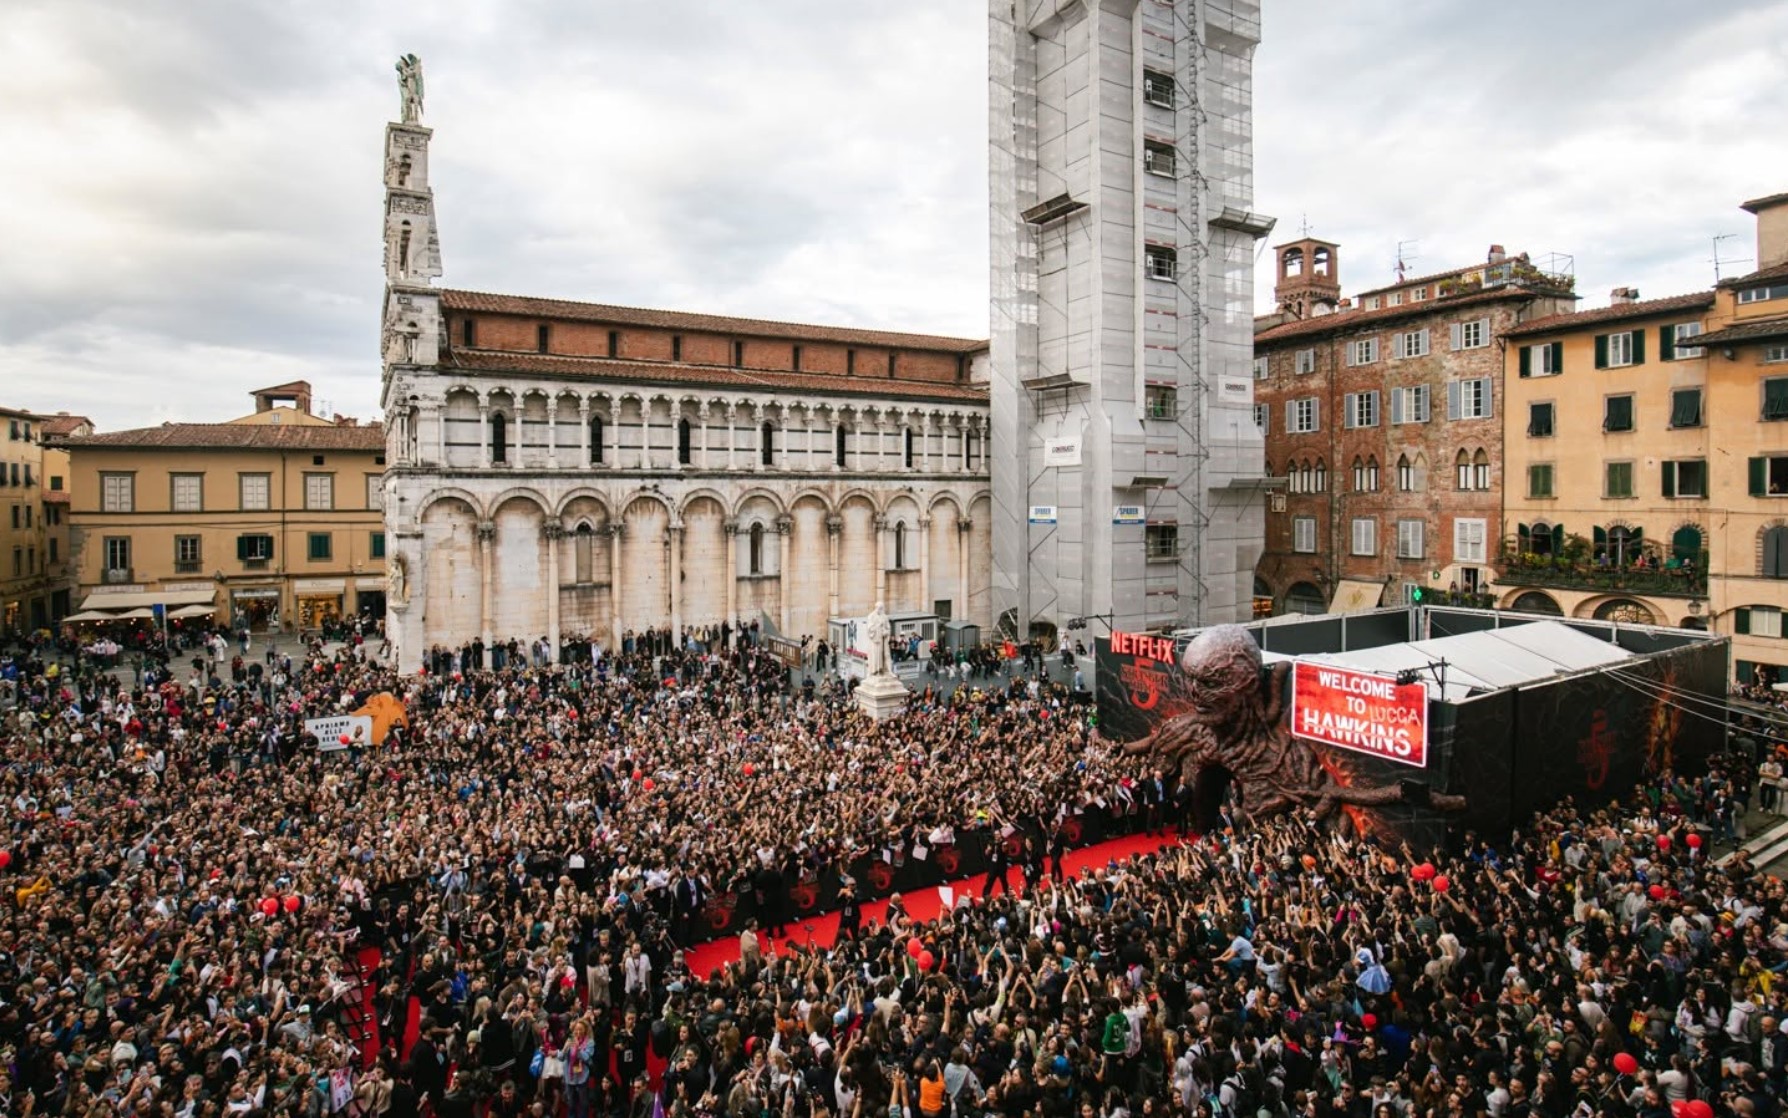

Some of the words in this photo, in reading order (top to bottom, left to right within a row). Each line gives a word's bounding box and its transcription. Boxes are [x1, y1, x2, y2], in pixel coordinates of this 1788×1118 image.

[1111, 631, 1176, 666] NETFLIX
[1319, 671, 1396, 700] WELCOME
[1346, 696, 1366, 715] TO
[1369, 705, 1421, 726] LUCCA
[1303, 707, 1412, 756] HAWKINS
